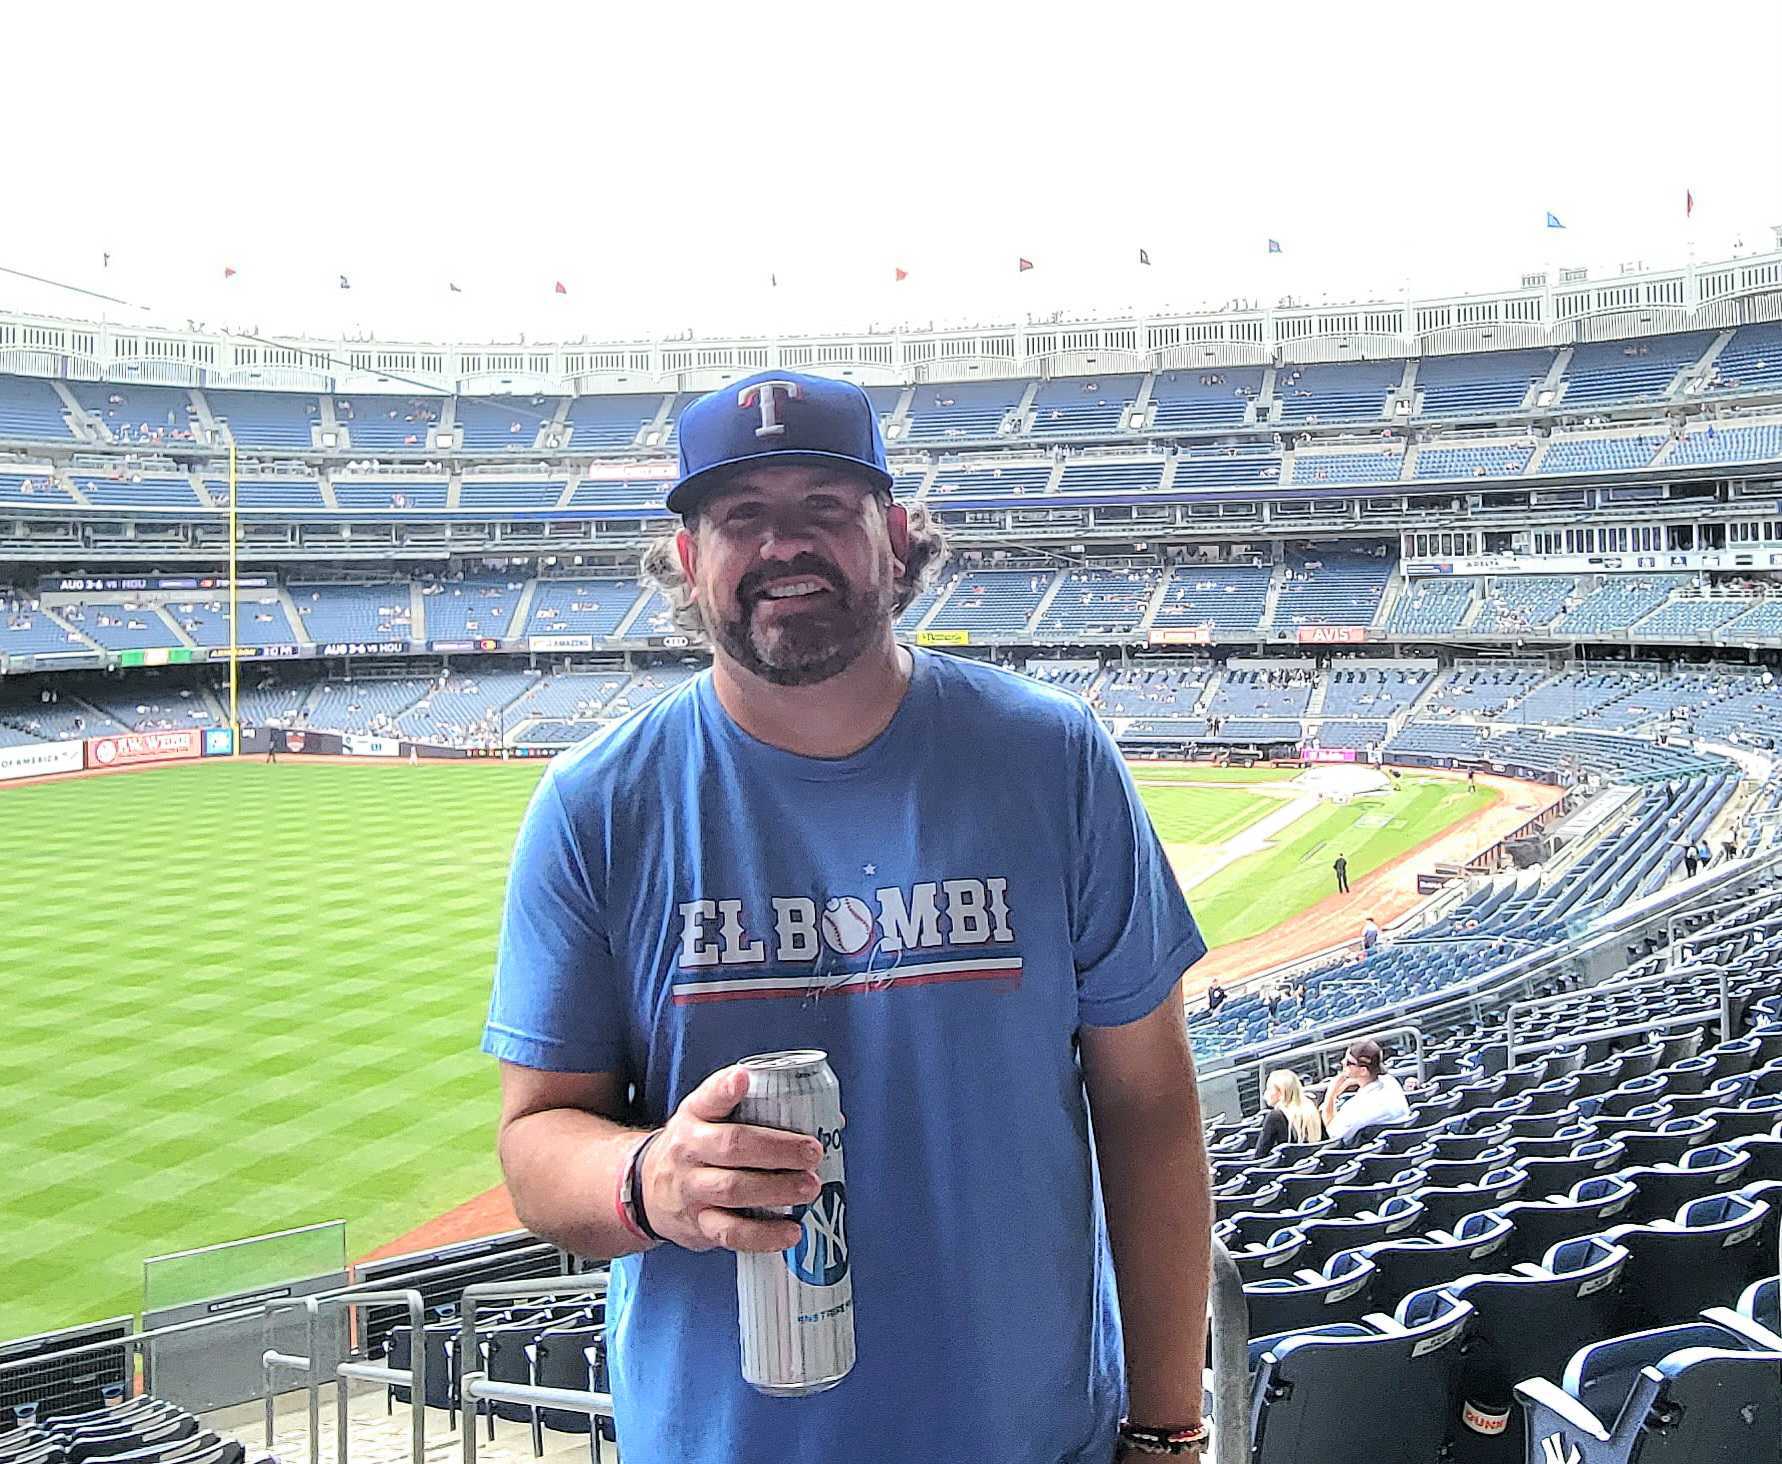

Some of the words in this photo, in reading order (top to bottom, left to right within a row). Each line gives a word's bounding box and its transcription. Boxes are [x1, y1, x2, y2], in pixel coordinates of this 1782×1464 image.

[737, 380, 804, 438] T
[60, 580, 84, 590] AUG
[1313, 628, 1350, 641] AVIS
[380, 643, 402, 653] HOU
[678, 899, 766, 968] EL
